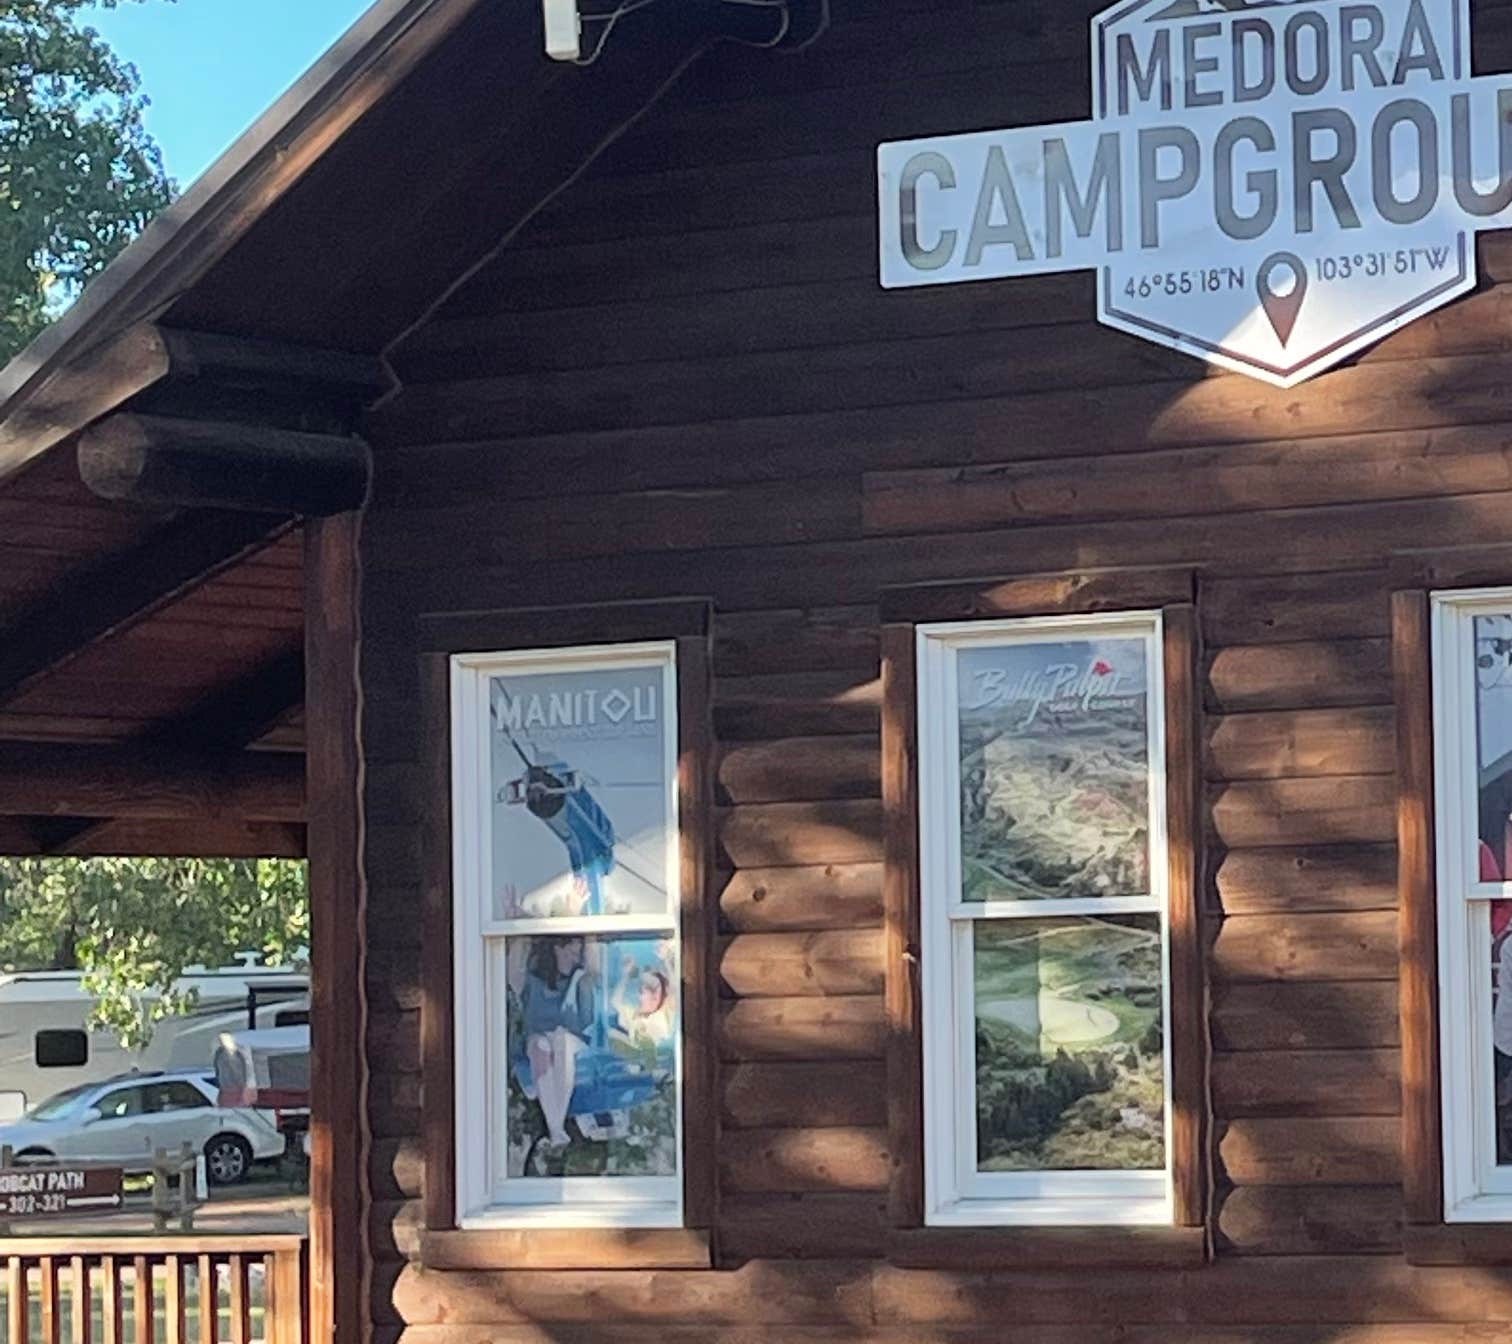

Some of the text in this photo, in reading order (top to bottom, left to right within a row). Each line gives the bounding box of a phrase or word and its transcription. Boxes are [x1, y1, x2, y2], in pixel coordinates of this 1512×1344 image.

[496, 685, 656, 729] MANITOU
[0, 1171, 85, 1192] OBCAT PATH
